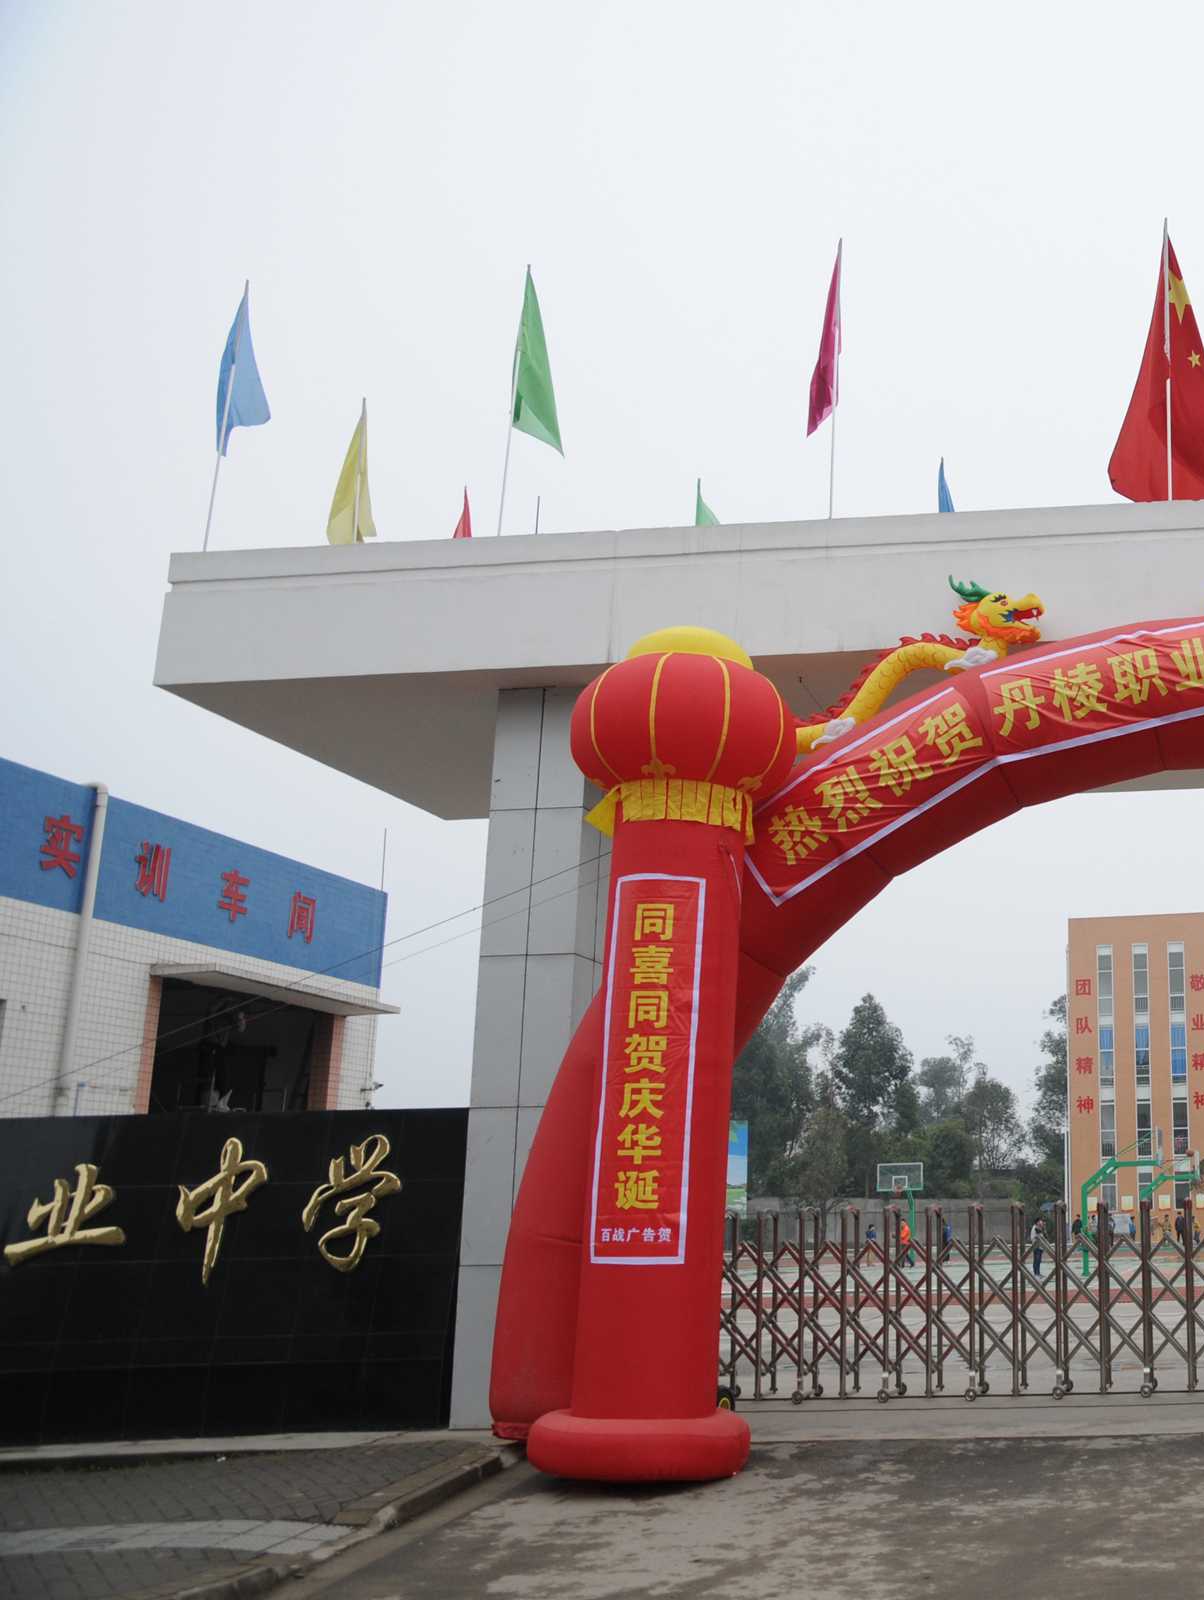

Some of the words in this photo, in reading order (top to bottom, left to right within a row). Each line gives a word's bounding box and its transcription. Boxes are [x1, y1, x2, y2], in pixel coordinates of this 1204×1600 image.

[39, 814, 317, 944] 实训车间
[614, 902, 675, 1210] 同喜同贺庆华诞
[1075, 978, 1094, 1114] 团队精神
[3, 1133, 402, 1288] 业中学
